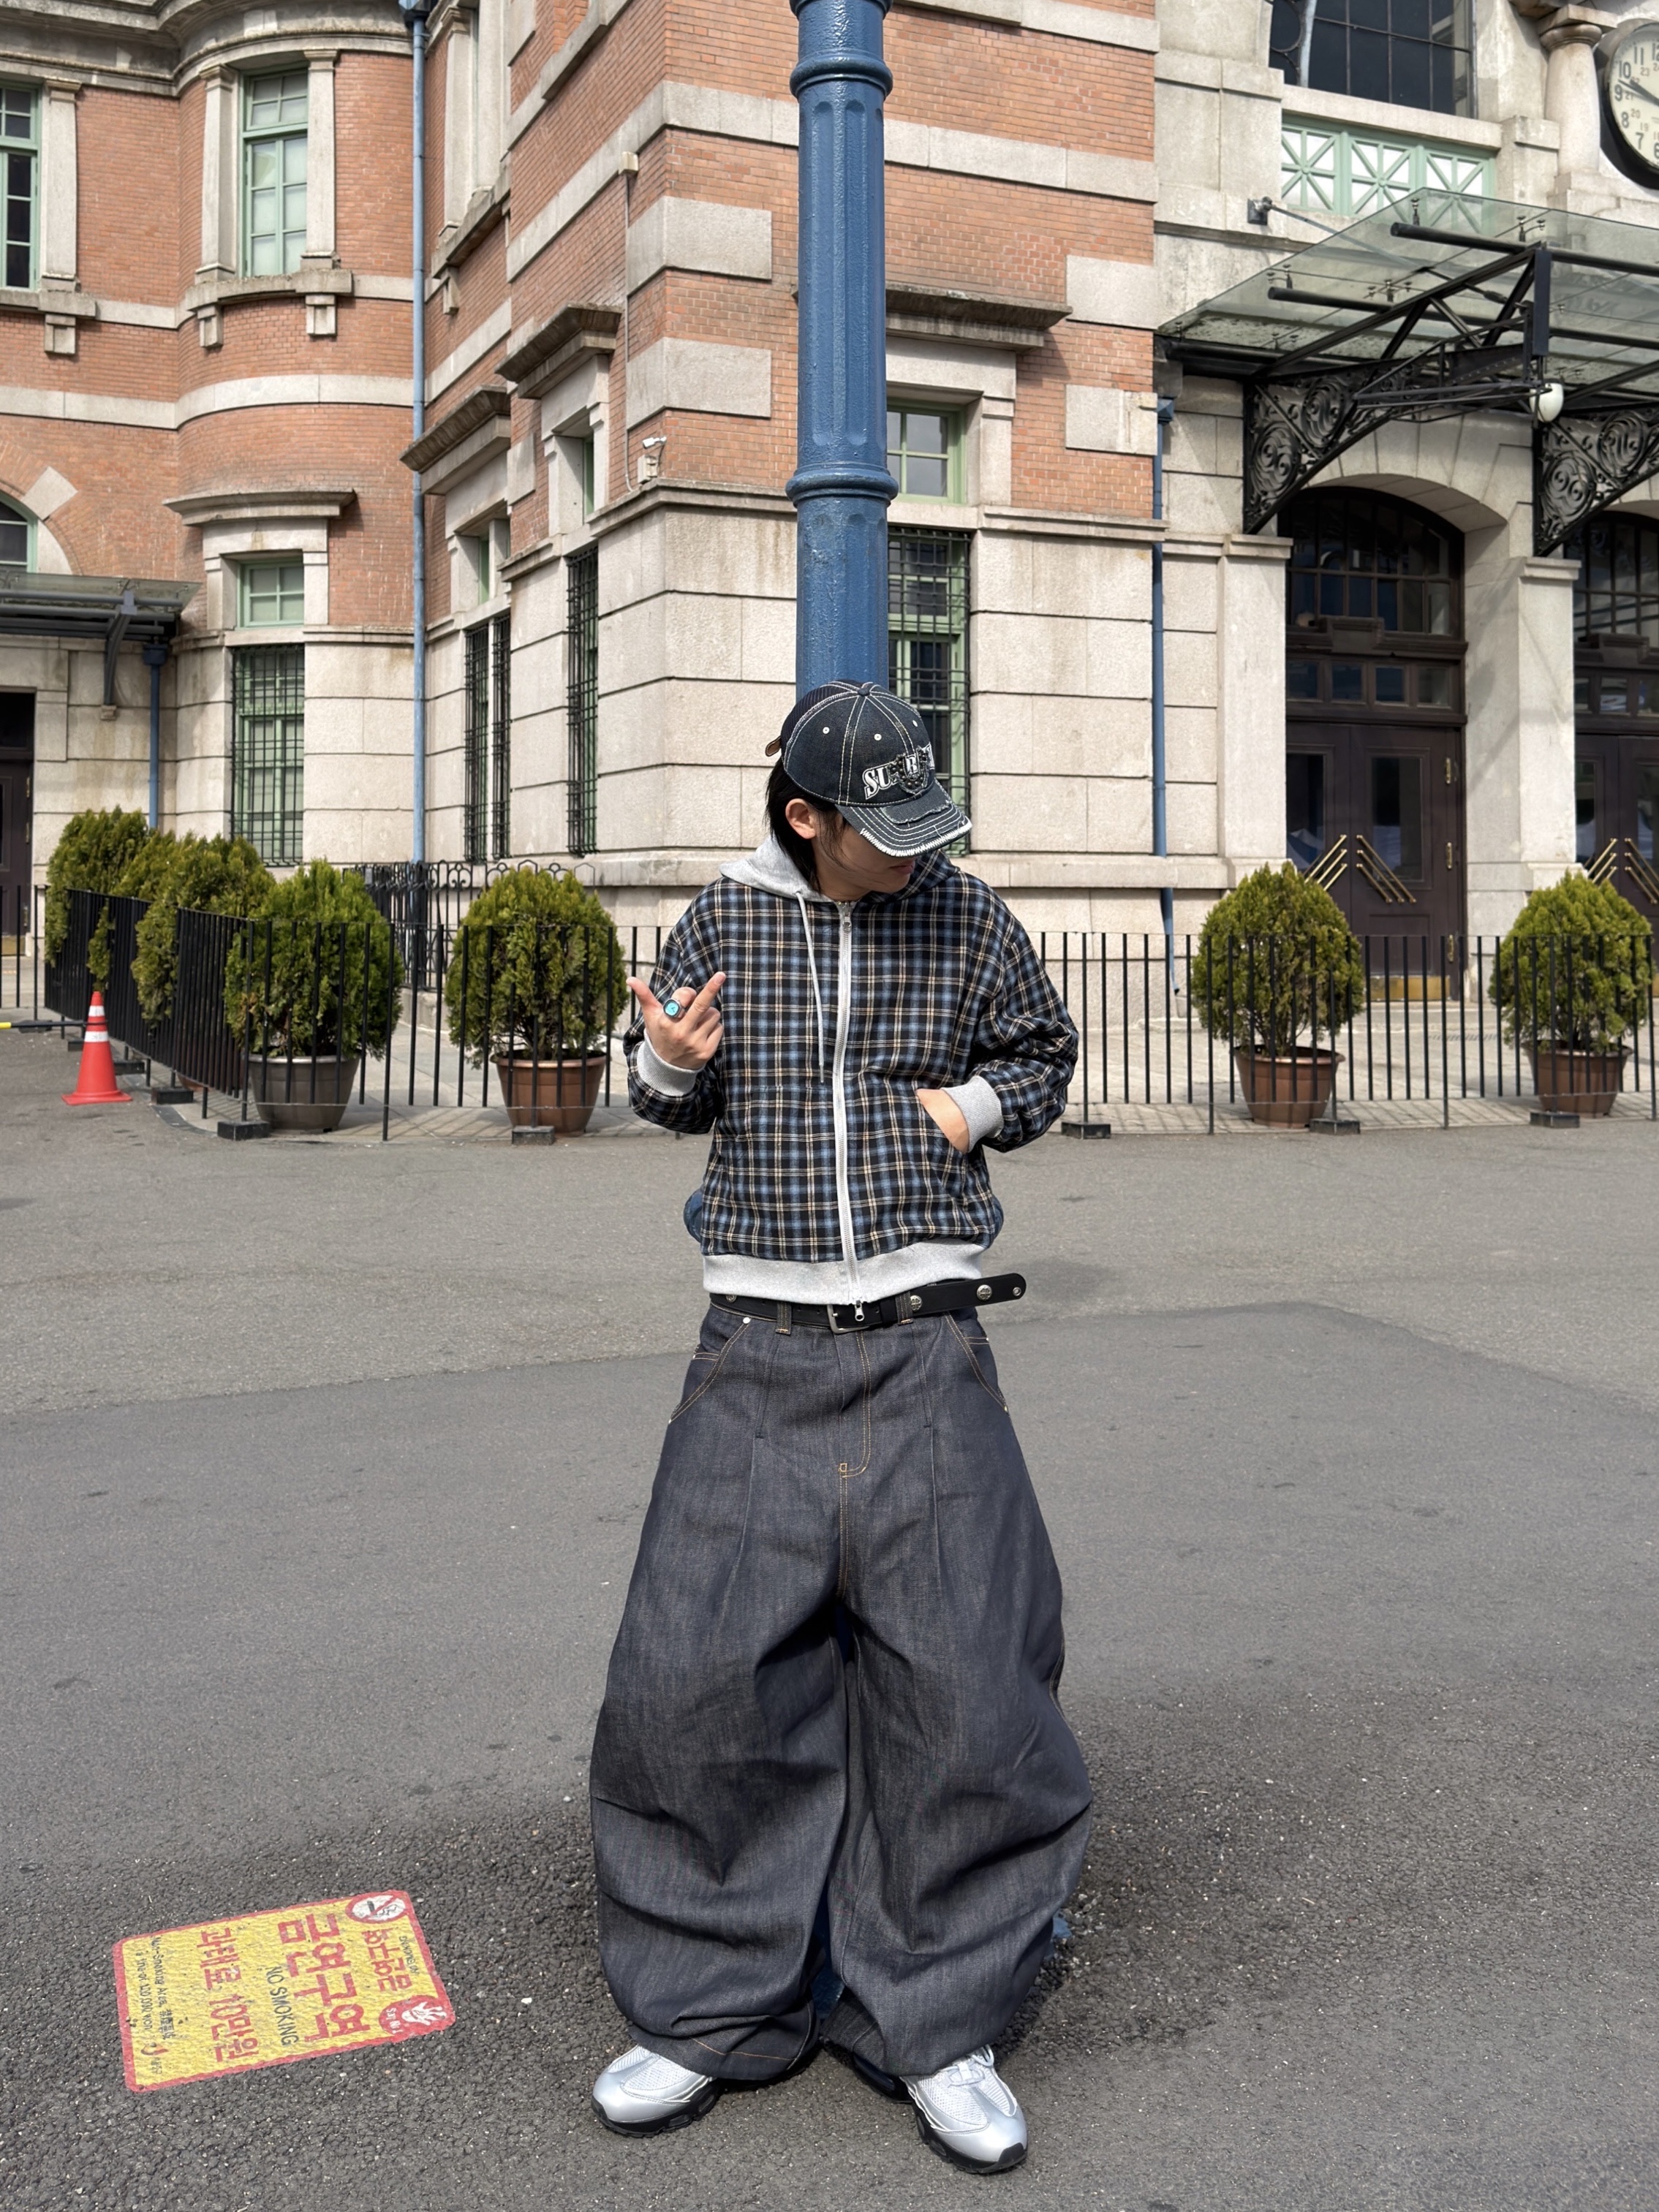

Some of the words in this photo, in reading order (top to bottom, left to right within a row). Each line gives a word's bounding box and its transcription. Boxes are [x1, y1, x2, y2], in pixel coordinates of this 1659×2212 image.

[1634, 46, 1644, 65] 11
[1619, 61, 1630, 78] 10
[1640, 67, 1649, 77] 23
[1614, 84, 1622, 101] 9
[1621, 111, 1630, 129] 8
[1631, 108, 1641, 118] 20
[1640, 122, 1649, 132] 19
[1635, 132, 1644, 150] 7
[196, 1928, 241, 1990] 과태료
[361, 1928, 412, 1991] 금연구역
[265, 1966, 284, 1985] NO
[278, 1913, 371, 2042] 금연구역
[270, 1987, 299, 2046] SMOKING
[209, 1993, 259, 2062] 10만원
